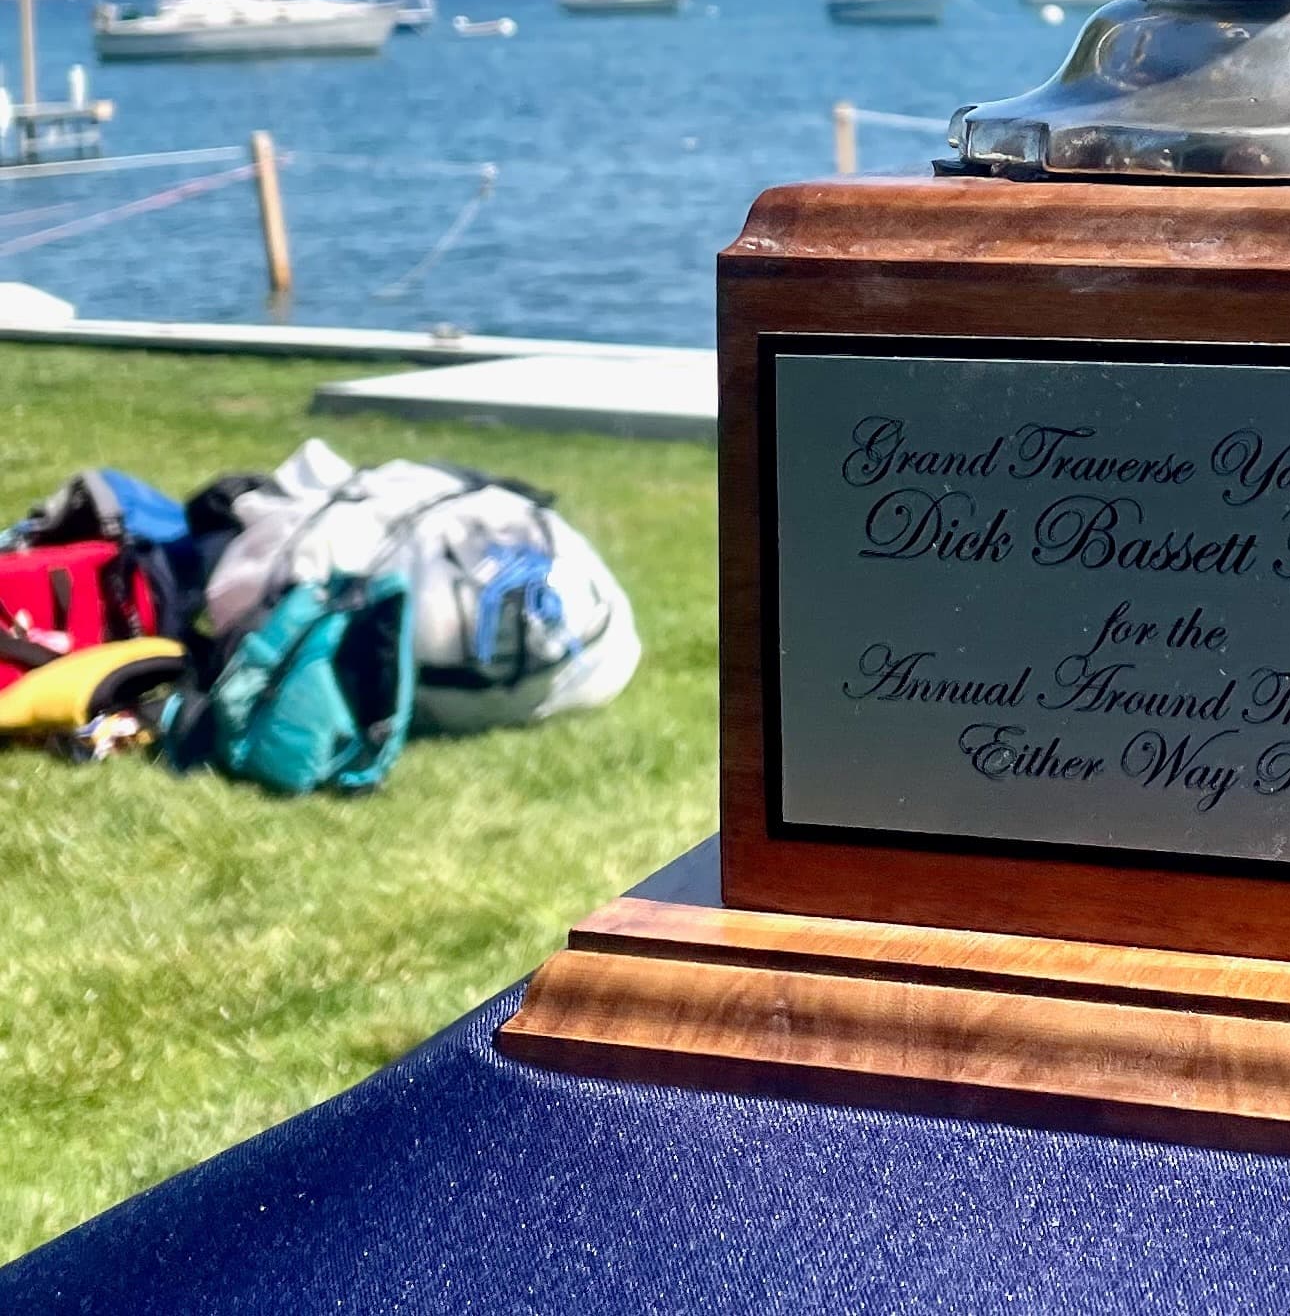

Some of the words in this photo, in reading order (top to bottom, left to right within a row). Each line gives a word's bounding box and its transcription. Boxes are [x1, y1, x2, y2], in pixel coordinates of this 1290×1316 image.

[842, 416, 1003, 486] Grand
[1009, 423, 1194, 484] Traverse
[859, 489, 1013, 561] Dick
[1031, 495, 1259, 575] Bassett
[1089, 601, 1157, 654] for
[1166, 608, 1228, 651] the
[842, 643, 1032, 709] Annual
[1037, 655, 1236, 720] Around
[958, 722, 1105, 780] Either
[1121, 728, 1241, 811] Way
